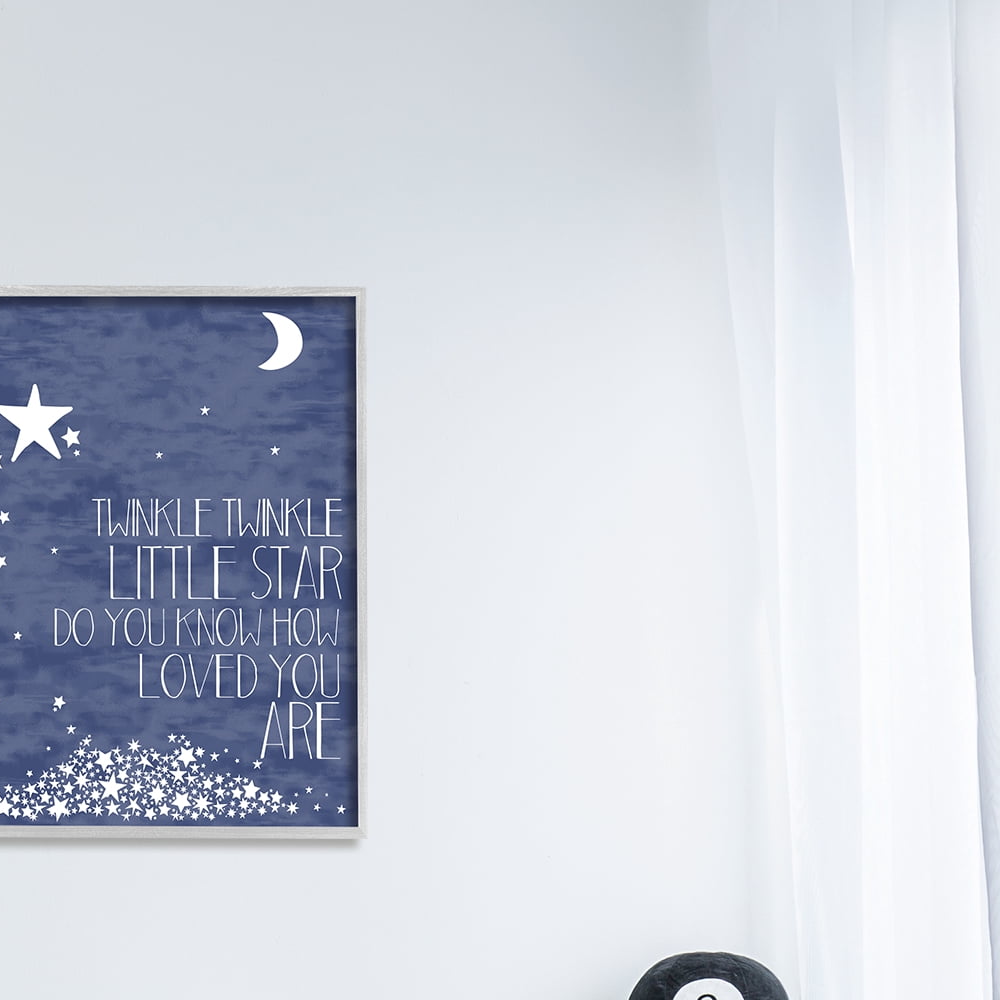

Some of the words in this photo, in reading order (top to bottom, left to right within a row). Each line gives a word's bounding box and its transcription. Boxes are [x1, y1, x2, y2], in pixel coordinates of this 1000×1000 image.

[91, 498, 212, 537] TWINKLE
[222, 498, 343, 537] TWINKLE
[109, 545, 237, 600] LITTLE
[251, 545, 343, 600] STAR
[53, 607, 95, 647] DO
[105, 607, 166, 647] YOU
[176, 607, 263, 647] KNOW
[273, 607, 340, 647] HOW
[138, 653, 258, 699] LOVED
[268, 653, 340, 699] YOU
[260, 701, 341, 760] ARE
